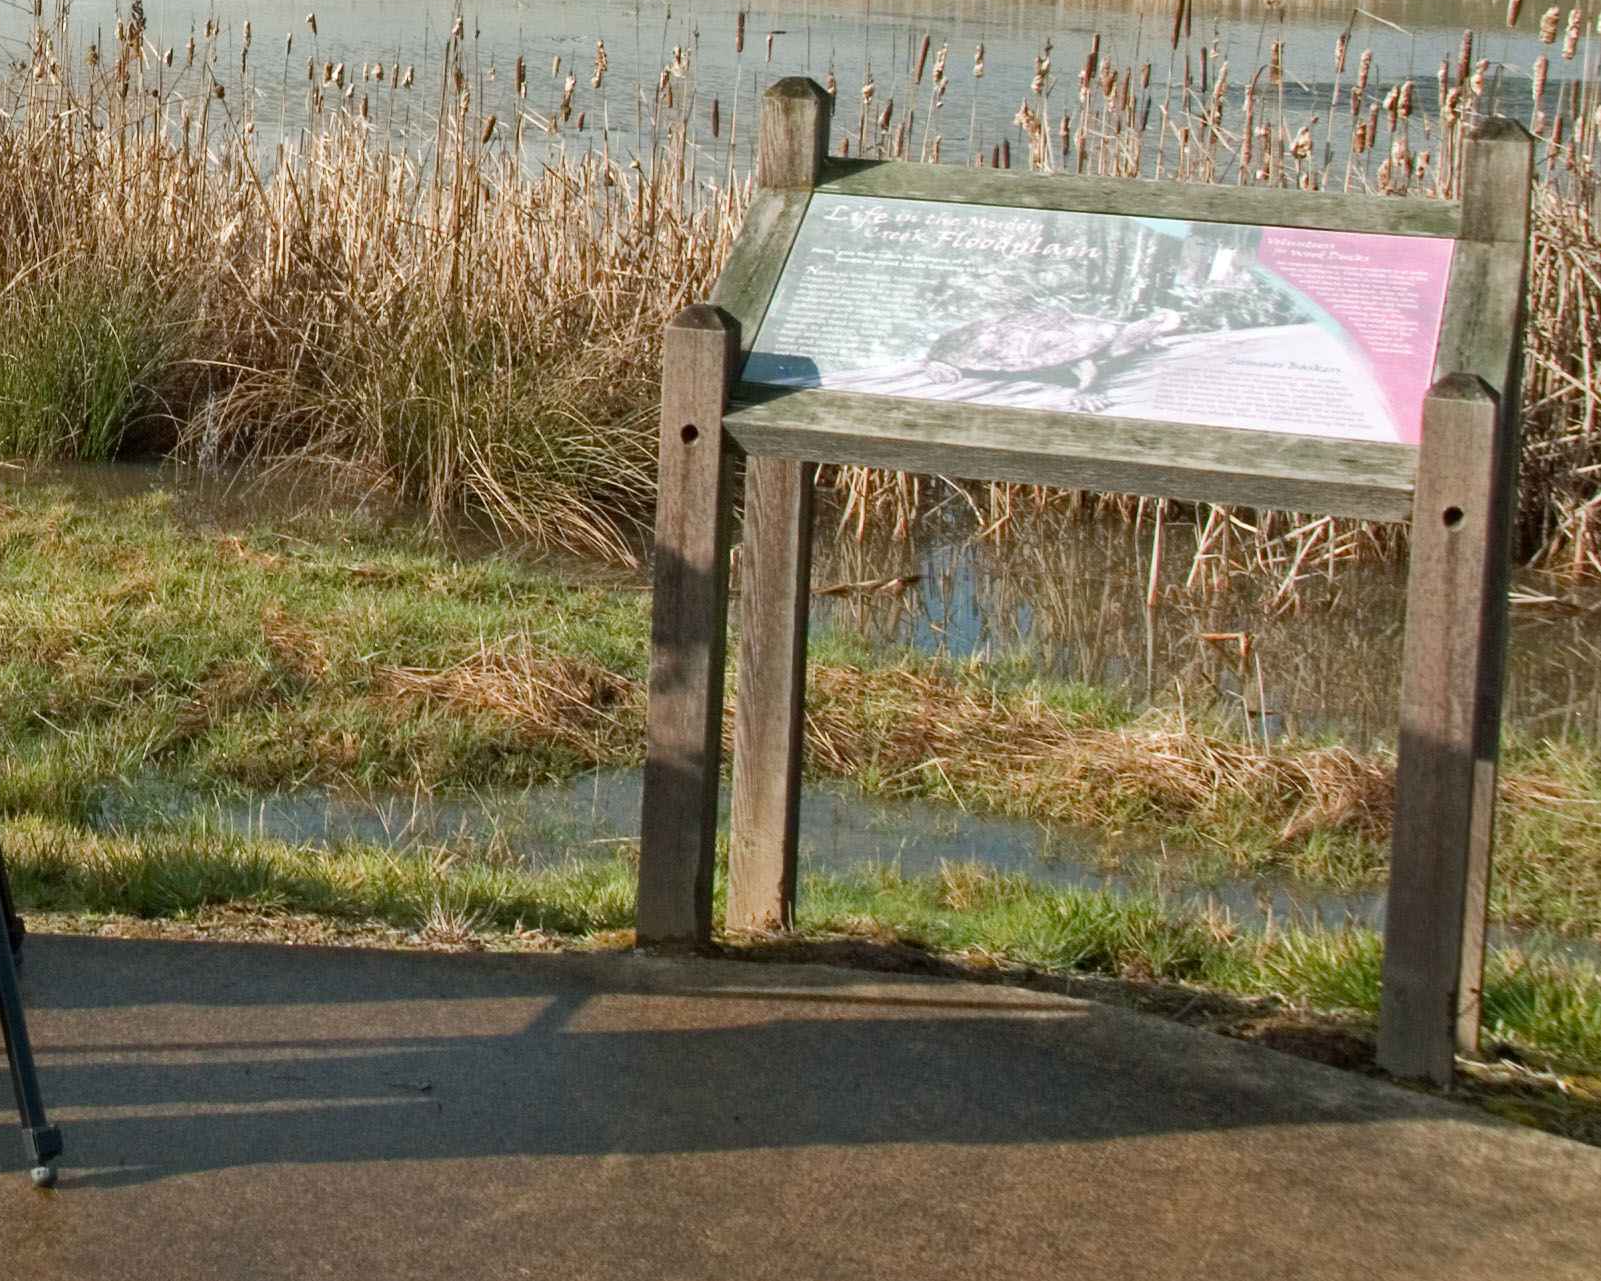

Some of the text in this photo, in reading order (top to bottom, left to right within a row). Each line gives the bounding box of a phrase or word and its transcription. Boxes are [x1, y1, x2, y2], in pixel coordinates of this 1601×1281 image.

[822, 205, 889, 231] Life
[895, 213, 918, 223] in
[925, 212, 961, 226] the
[863, 226, 1103, 258] Creek Floodplain
